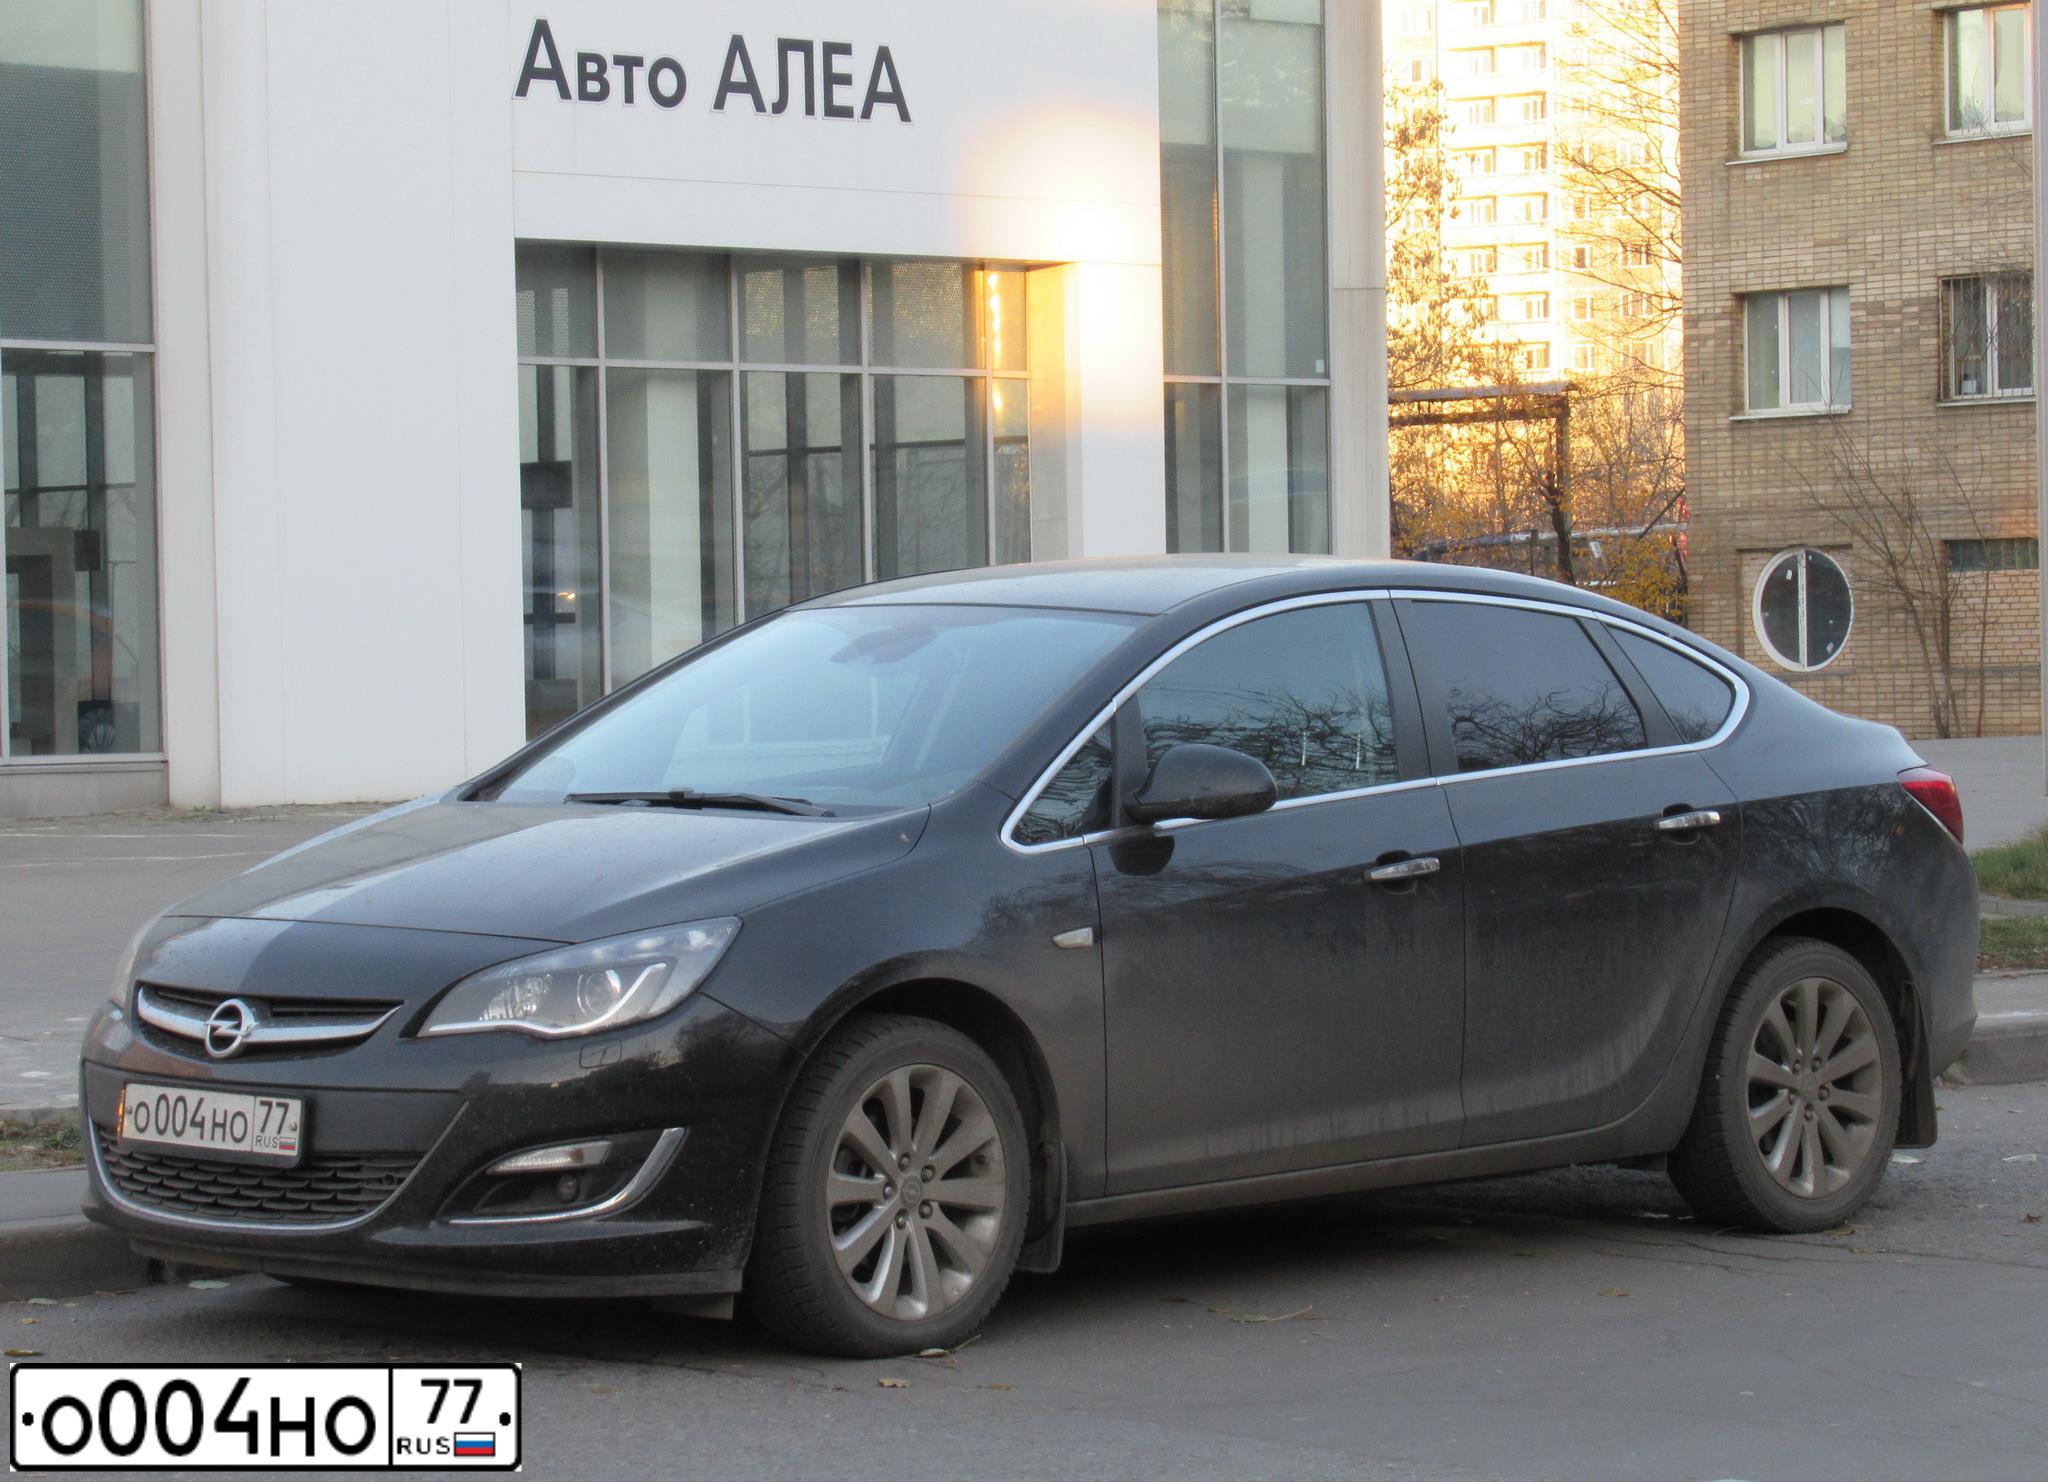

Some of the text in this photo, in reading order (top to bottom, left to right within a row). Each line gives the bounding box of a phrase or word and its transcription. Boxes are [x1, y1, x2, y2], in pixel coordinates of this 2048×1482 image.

[713, 34, 912, 123] АЛЕА
[259, 1100, 290, 1135] 77
[255, 1135, 279, 1148] RUS
